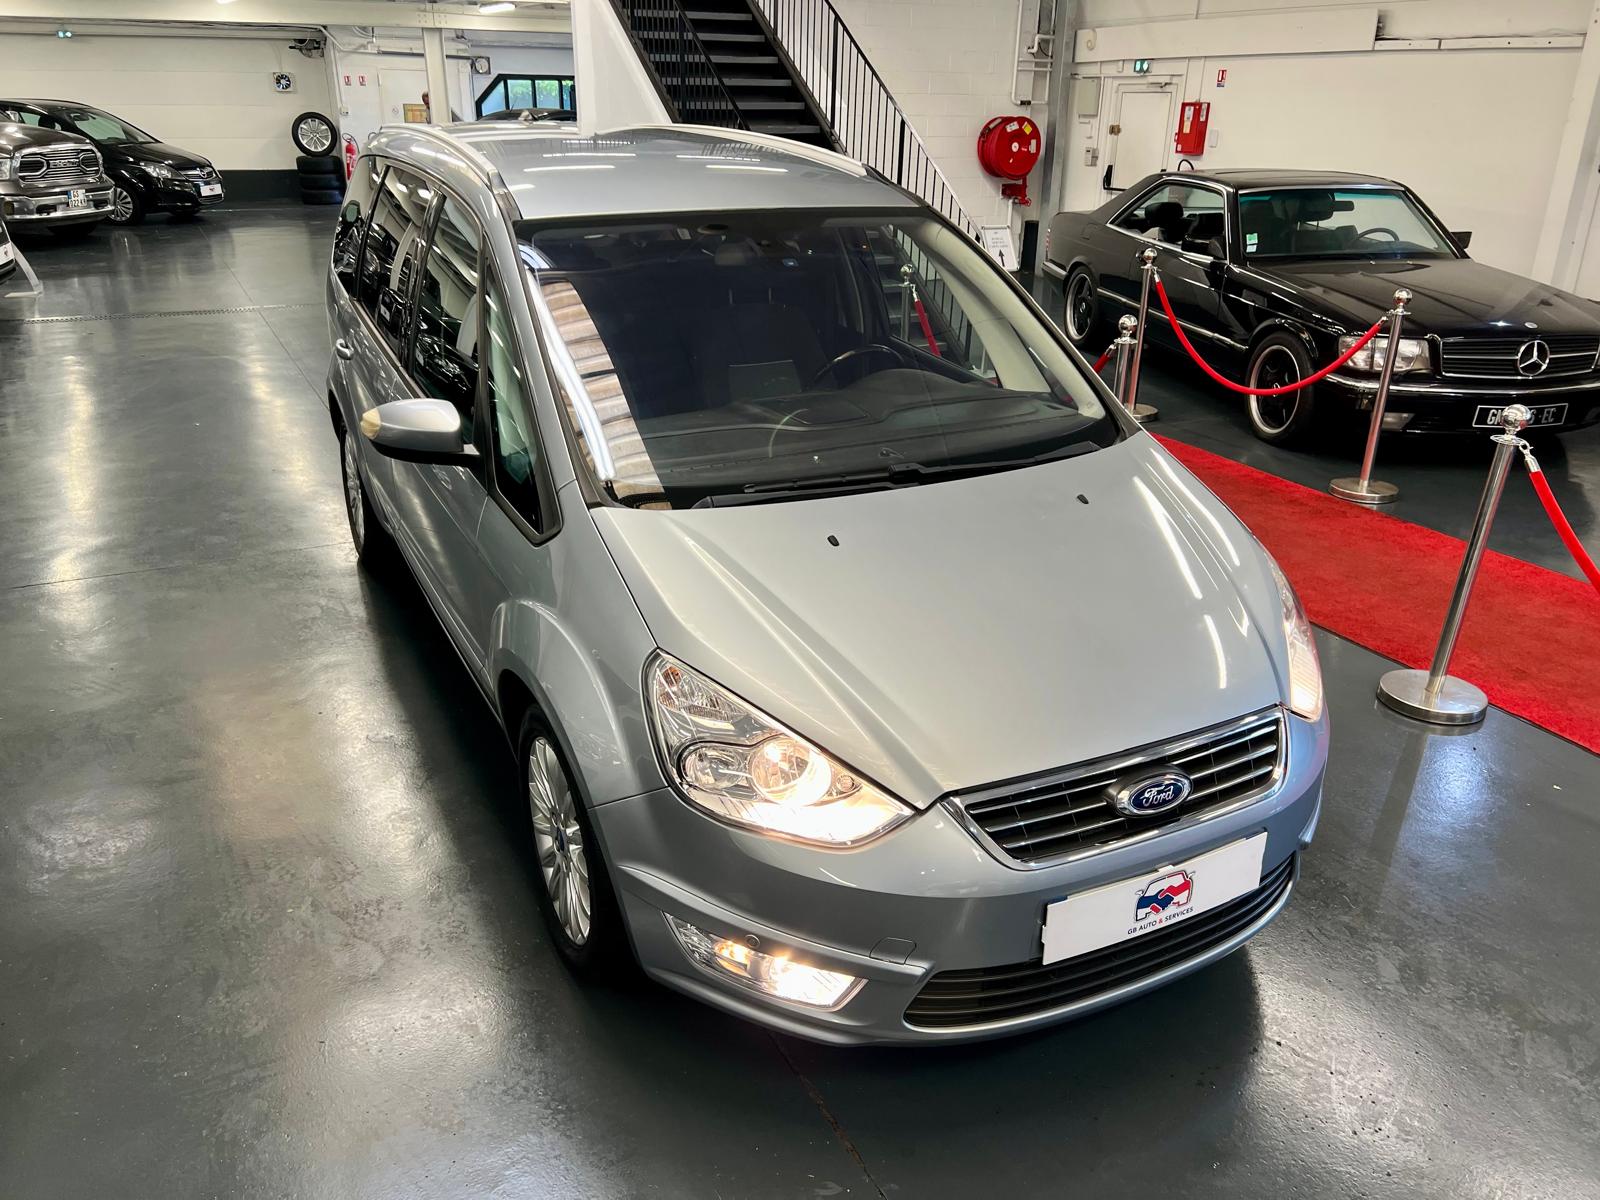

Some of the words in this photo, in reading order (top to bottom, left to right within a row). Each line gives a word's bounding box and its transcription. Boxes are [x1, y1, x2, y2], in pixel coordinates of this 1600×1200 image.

[1140, 785, 1175, 807] Ford
[1127, 926, 1138, 935] GB
[1138, 920, 1157, 932] AUTO
[1158, 917, 1164, 925] &
[1164, 907, 1193, 922] SERVICES
